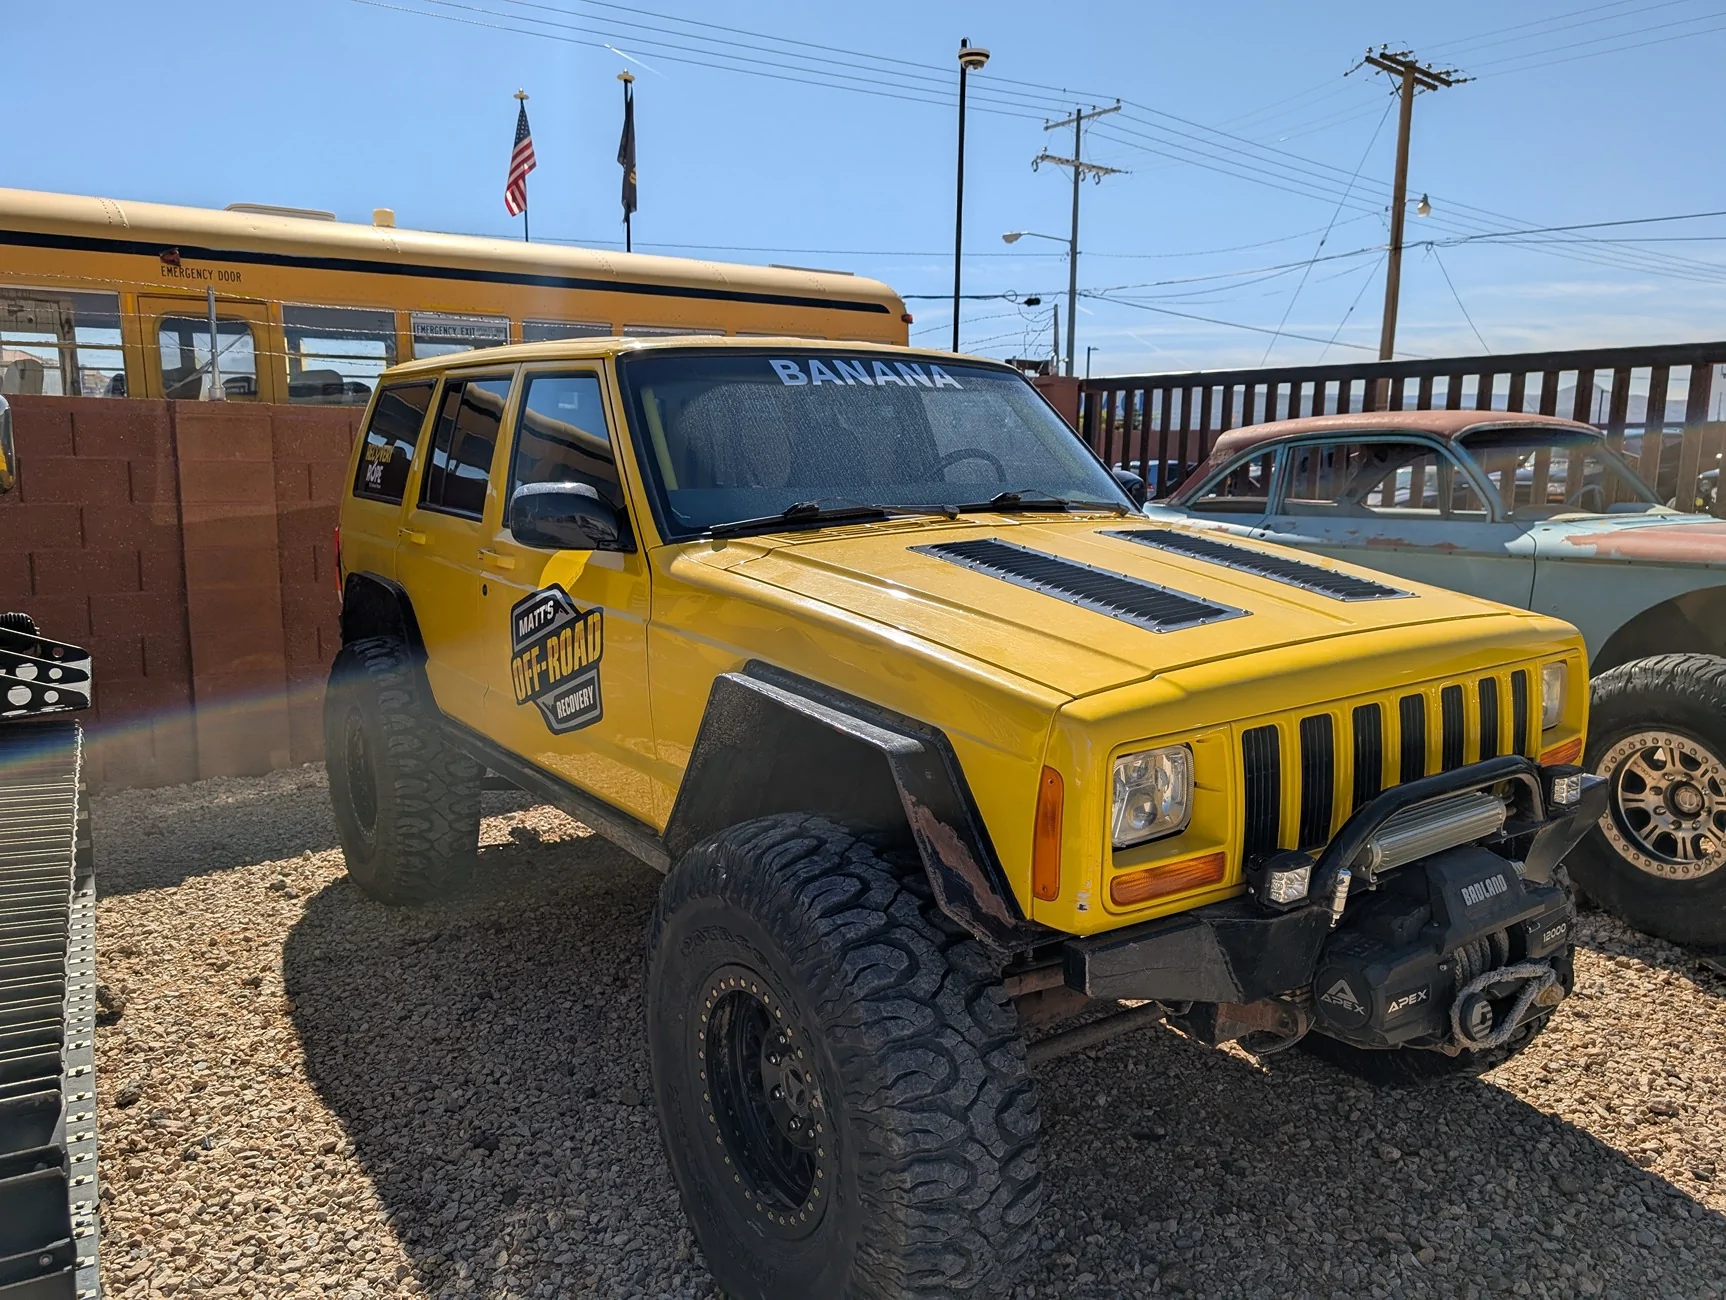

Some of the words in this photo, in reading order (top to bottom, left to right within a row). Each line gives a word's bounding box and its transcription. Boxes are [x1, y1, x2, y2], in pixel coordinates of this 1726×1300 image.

[161, 265, 213, 281] EMERGENCY
[218, 270, 242, 283] DOOR
[416, 324, 457, 336] EMERGENCY
[460, 326, 476, 337] EXIT
[768, 358, 964, 391] BANANA
[518, 600, 554, 637] MATT'S
[512, 611, 601, 702] OFF-ROAD
[556, 685, 594, 720] RECOVERY
[1461, 873, 1508, 906] BADLAND
[1542, 922, 1568, 943] 12000
[1320, 992, 1366, 1016] APEX
[1387, 988, 1428, 1013] APEX
